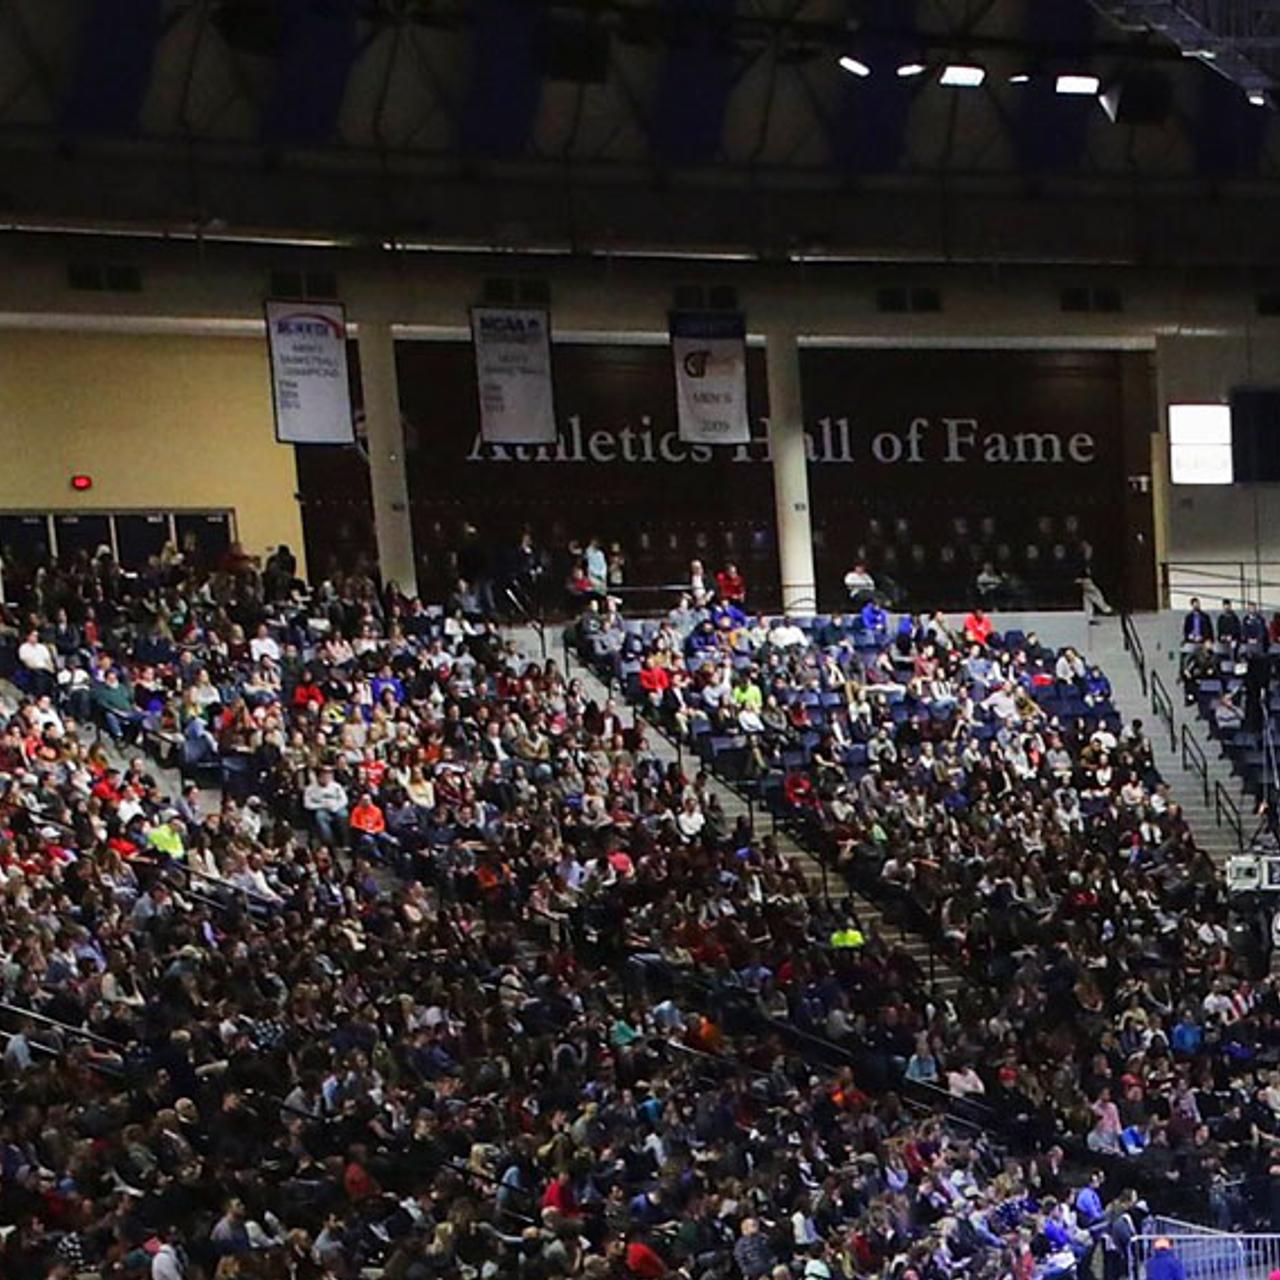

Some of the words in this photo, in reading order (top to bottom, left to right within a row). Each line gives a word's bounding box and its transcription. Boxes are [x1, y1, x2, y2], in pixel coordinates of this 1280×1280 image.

[466, 415, 713, 462] letics
[871, 418, 929, 462] of
[941, 418, 1095, 462] Fame
